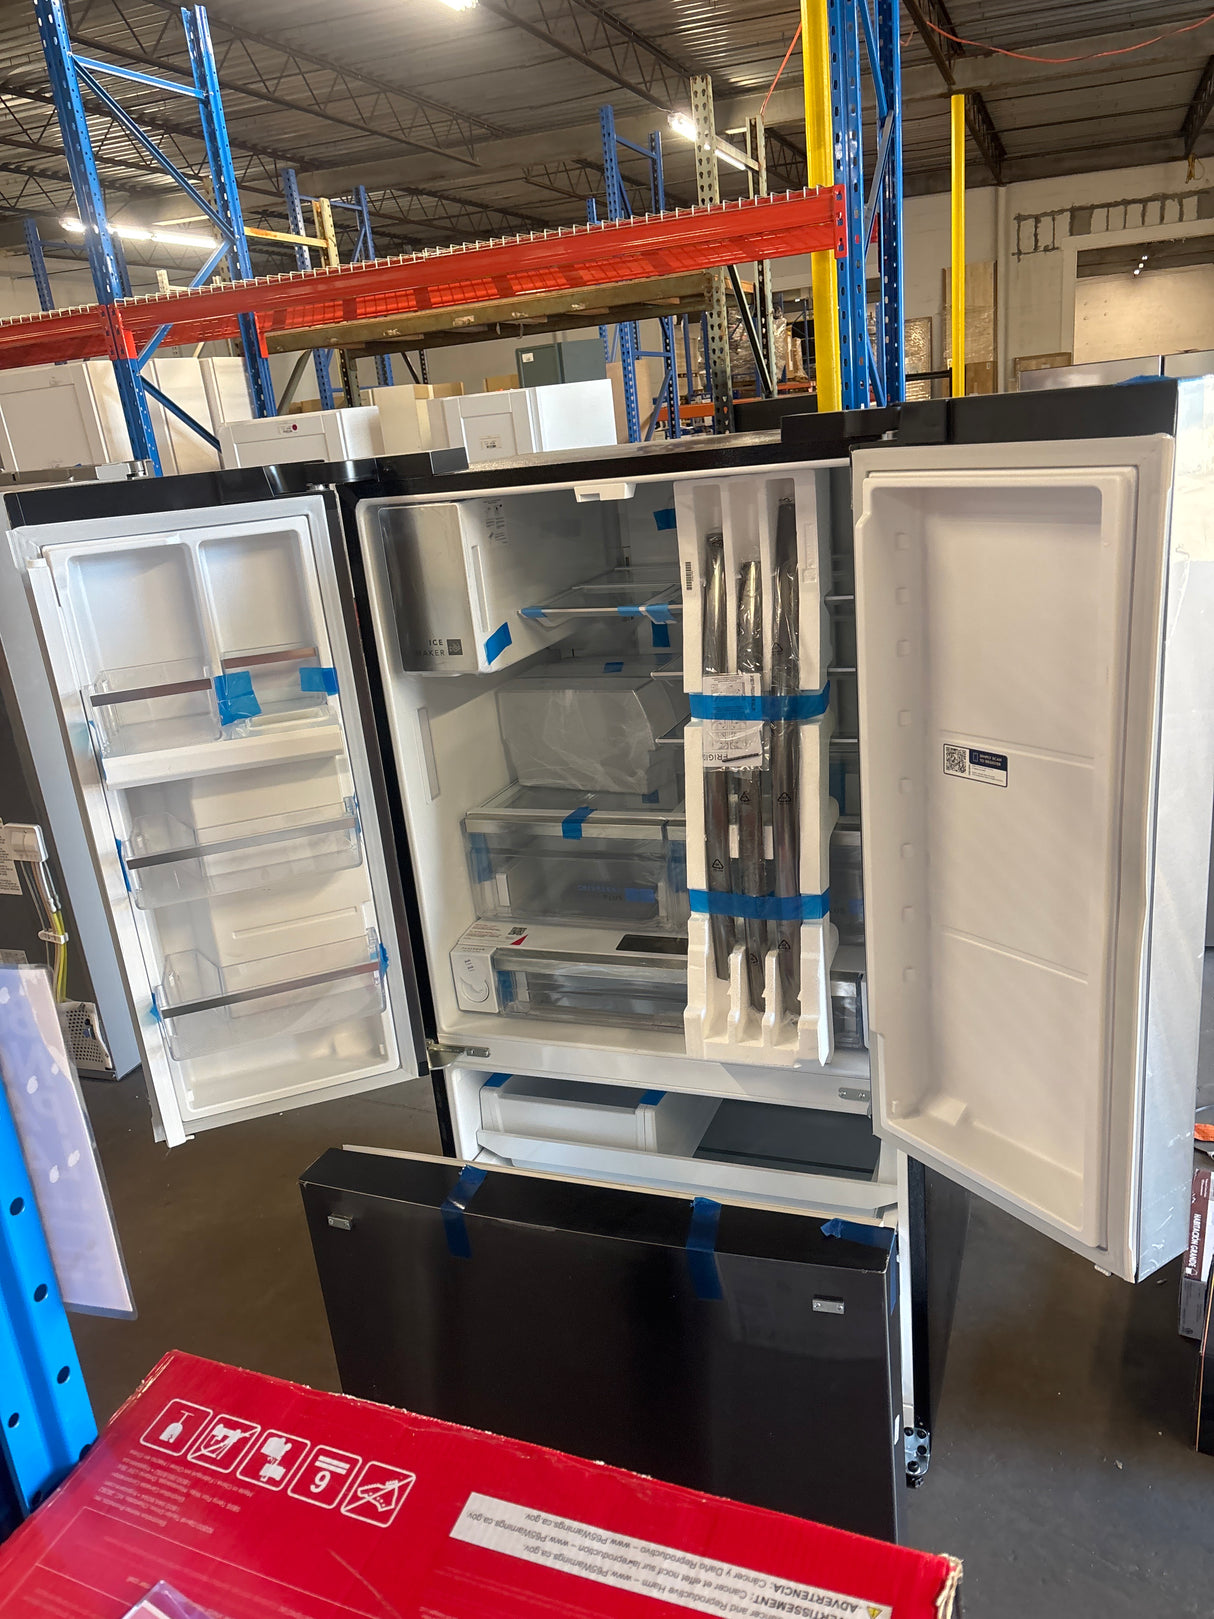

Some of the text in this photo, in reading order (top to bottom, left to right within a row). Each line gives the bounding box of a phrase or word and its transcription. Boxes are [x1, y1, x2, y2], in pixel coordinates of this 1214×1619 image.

[1189, 1213, 1201, 1267] HABITACIÓN GRANDE
[578, 1545, 630, 1565] reproduction
[640, 1546, 697, 1569] Reproductivo
[642, 1564, 656, 1572] sur
[656, 1568, 679, 1579] nocif
[699, 1563, 723, 1576] Daño
[642, 1580, 666, 1593] Harm
[681, 1575, 701, 1585] effet
[733, 1573, 766, 1588] Cáncer
[668, 1587, 728, 1611] Reproductive
[714, 1584, 747, 1599] Cancer
[770, 1583, 858, 1613] ADVERTENCIA:
[729, 1604, 748, 1614] and
[750, 1594, 843, 1619] RTISSEMENT:
[750, 1611, 782, 1619] ncer
